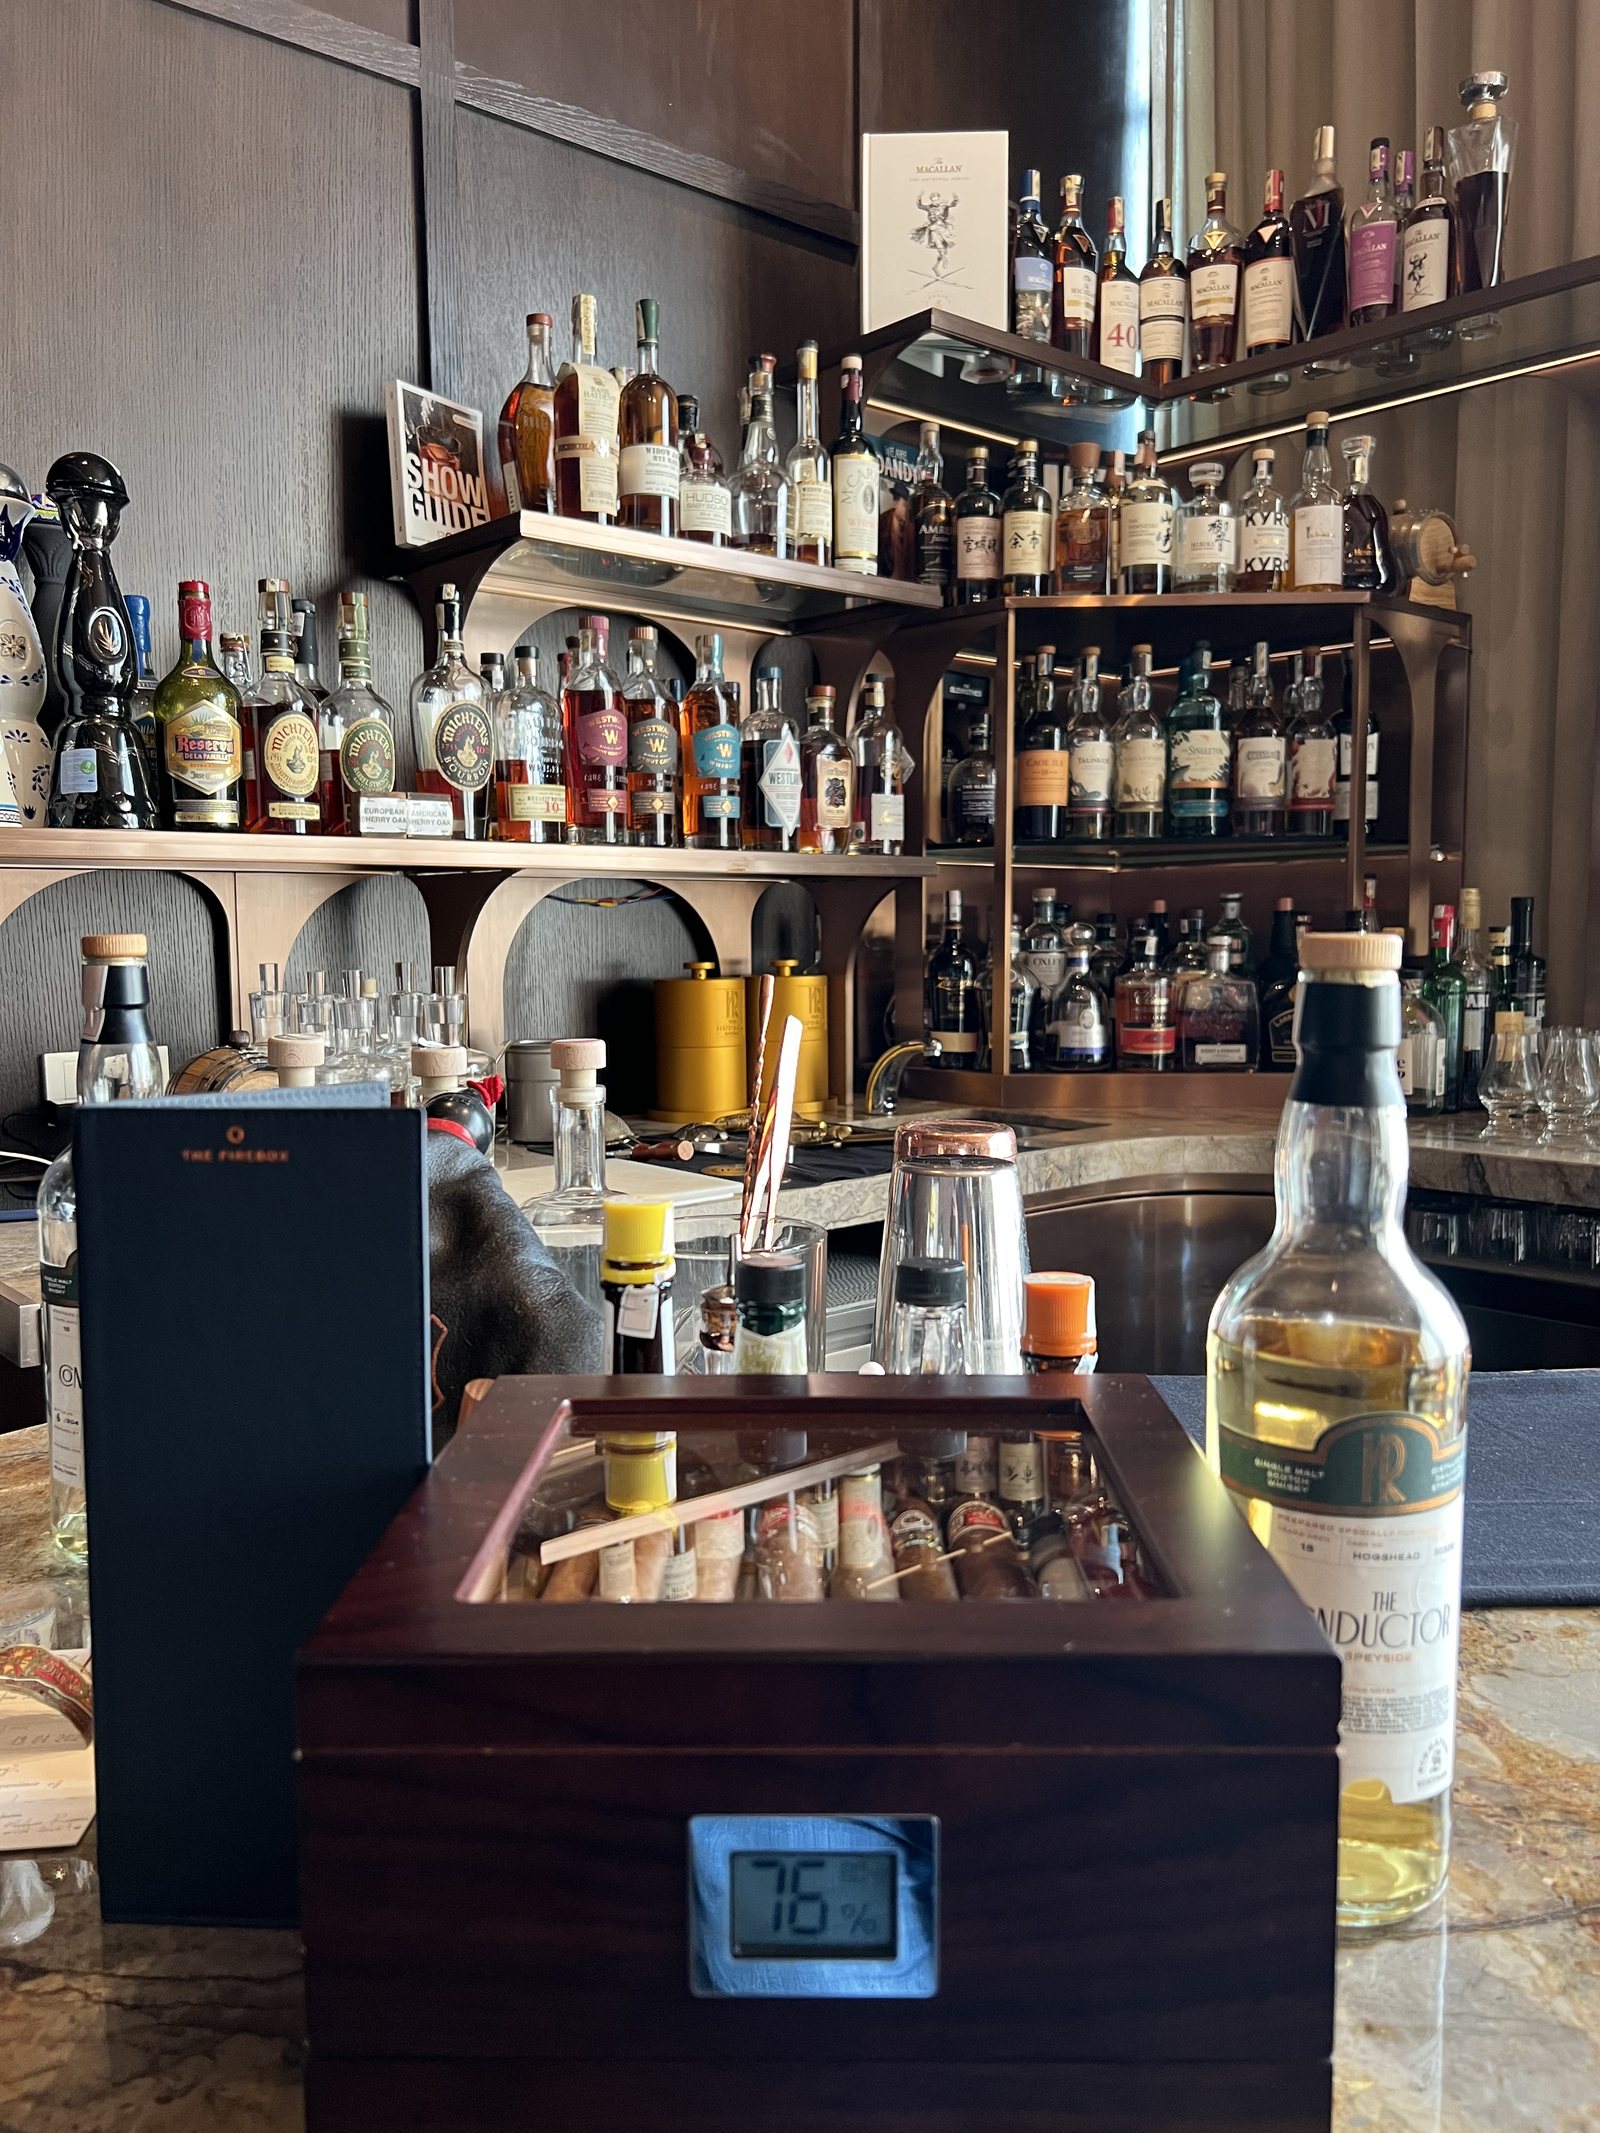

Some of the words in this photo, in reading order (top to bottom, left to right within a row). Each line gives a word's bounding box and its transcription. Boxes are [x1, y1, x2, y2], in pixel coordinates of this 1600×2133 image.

[916, 165, 962, 173] MACALLAN
[1196, 284, 1230, 294] MACALLAN
[1250, 280, 1282, 291] MACALLAN
[1107, 322, 1136, 349] 40
[407, 453, 482, 507] SHOW
[685, 493, 728, 506] HUDSO
[409, 488, 487, 530] GUIDE
[443, 712, 489, 746] MICHTER'S
[603, 729, 619, 744] W
[632, 725, 669, 736] WESTWA
[176, 735, 234, 752] Reserva
[272, 723, 316, 754] MICHTER'S
[349, 730, 391, 759] MICHTER'S
[717, 743, 732, 757] W
[444, 755, 489, 781] BOURBON
[1026, 757, 1048, 767] CAOL
[769, 772, 799, 785] WESTLA
[411, 810, 447, 818] AMERICAN
[544, 801, 560, 813] 10
[219, 1151, 289, 1161] FIREBOX
[1254, 1457, 1291, 1473] SINGLE
[1295, 1467, 1325, 1478] MALT
[1267, 1470, 1311, 1485] SCOTCH
[1267, 1479, 1311, 1494] WHISKY
[1277, 1513, 1334, 1532] PREPARED
[1338, 1526, 1394, 1537] SPECIALLY
[1352, 1551, 1421, 1561] HOGSHEAD
[1372, 1591, 1398, 1612] THE
[1314, 1603, 1450, 1649] NDUCTOR
[1345, 1652, 1413, 1662] SPEYSIDE
